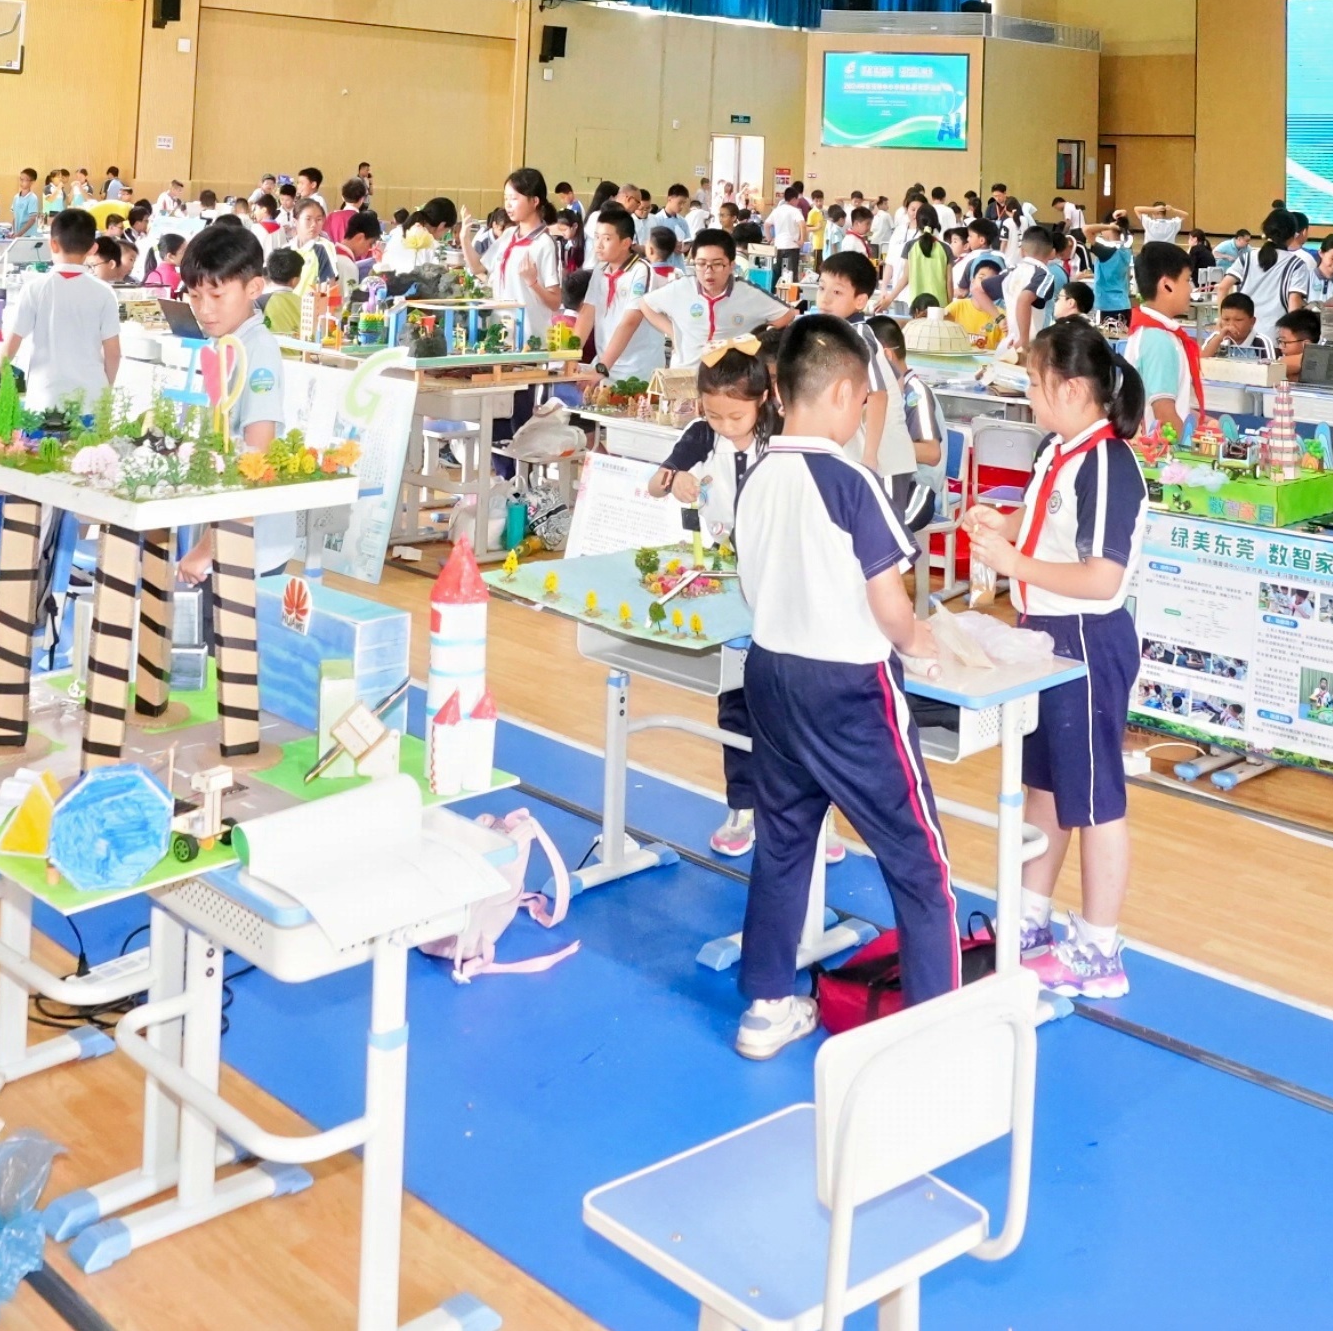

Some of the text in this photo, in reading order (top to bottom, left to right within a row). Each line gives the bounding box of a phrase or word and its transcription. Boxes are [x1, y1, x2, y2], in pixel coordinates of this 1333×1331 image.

[344, 346, 409, 424] G
[1208, 496, 1274, 524] 数智家园
[1170, 526, 1255, 561] 绿美东莞
[282, 613, 306, 634] HUAWEI
